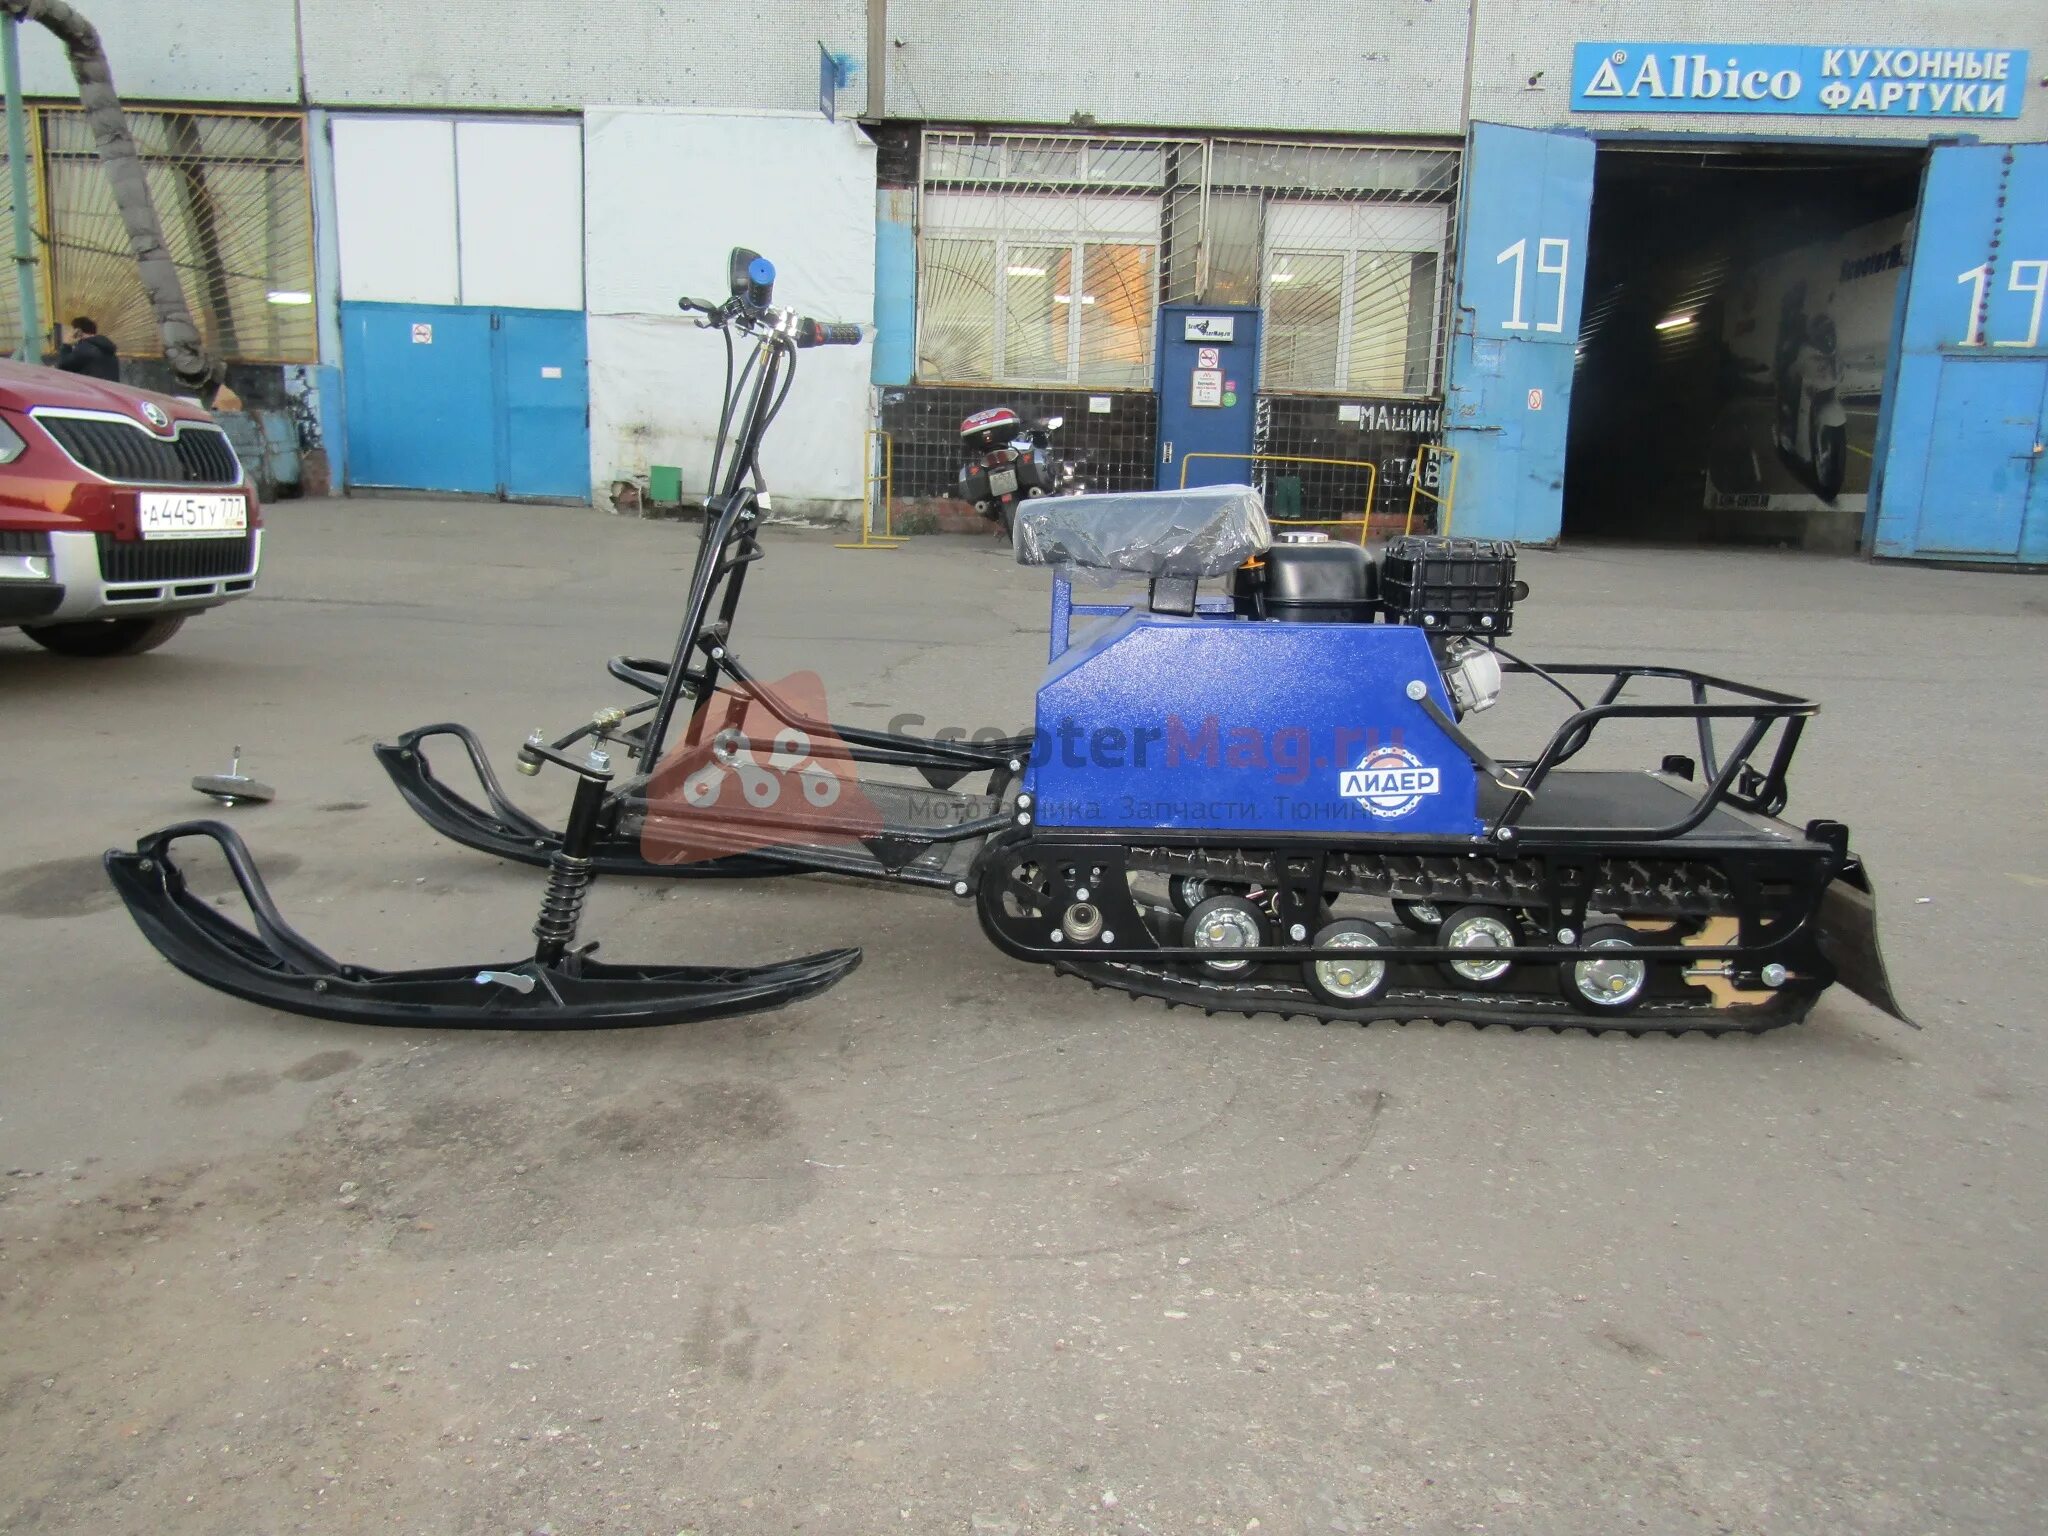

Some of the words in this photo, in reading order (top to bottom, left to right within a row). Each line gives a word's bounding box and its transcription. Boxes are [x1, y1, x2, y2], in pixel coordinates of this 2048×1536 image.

[1627, 53, 1802, 100] Albico
[1820, 49, 2011, 80] КУХОННЫЕ
[1818, 80, 2009, 114] ФАРТУКИ
[1496, 237, 1569, 334] 19
[1957, 260, 2048, 348] 19
[220, 498, 241, 519] 777
[1345, 772, 1435, 793] ЛИДЕР
